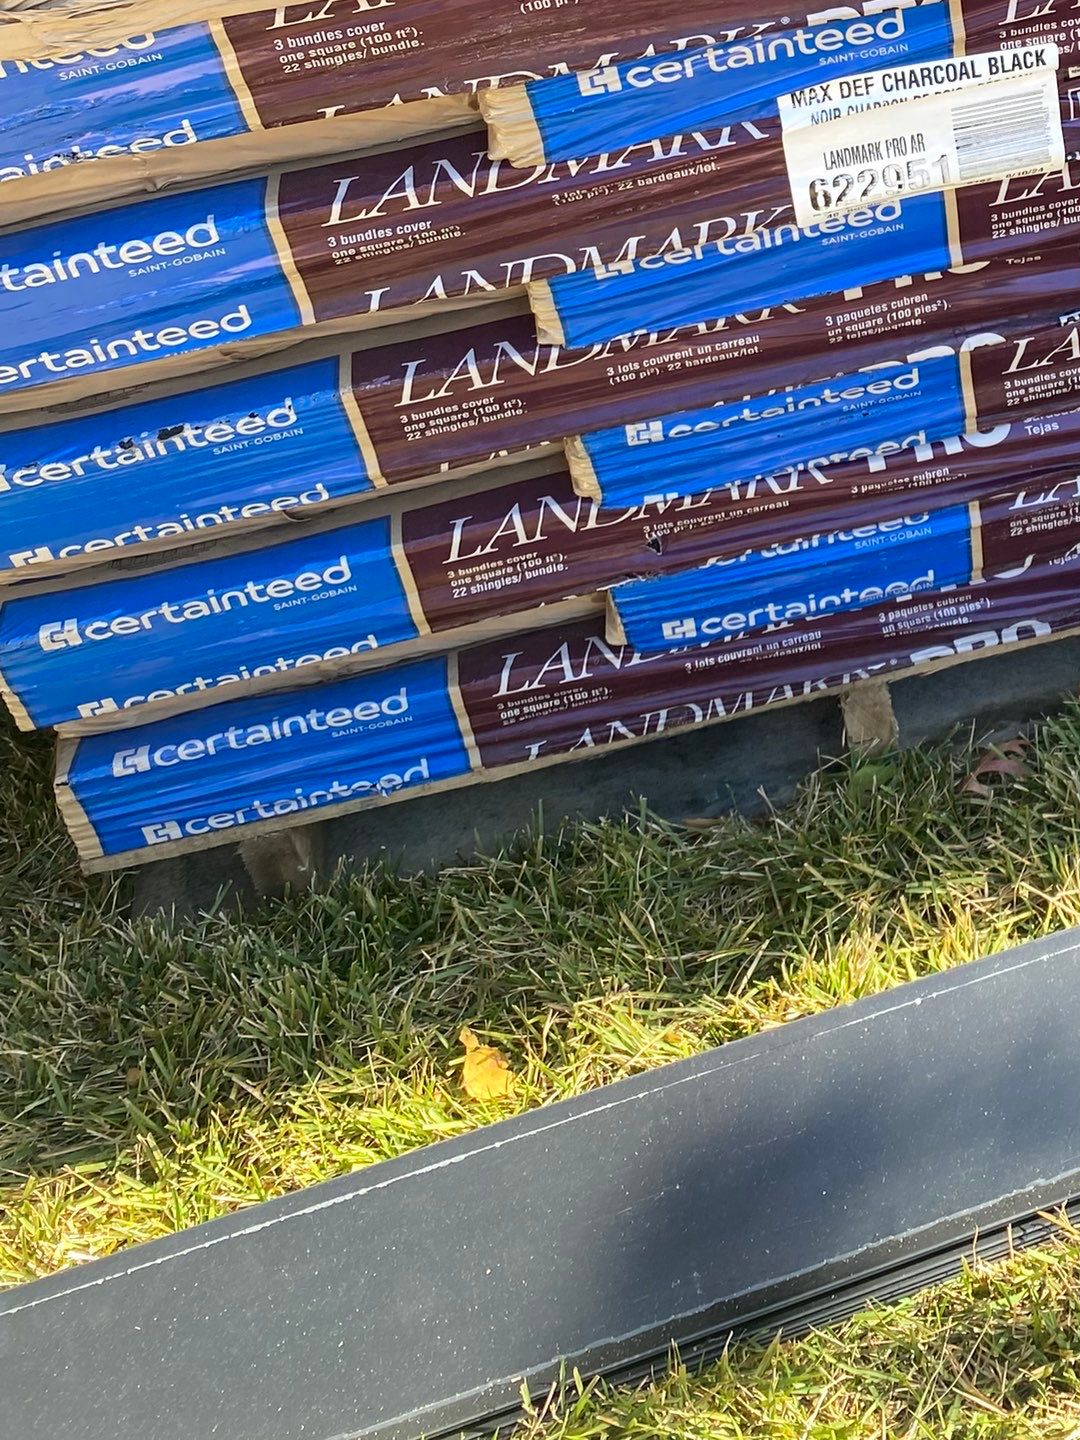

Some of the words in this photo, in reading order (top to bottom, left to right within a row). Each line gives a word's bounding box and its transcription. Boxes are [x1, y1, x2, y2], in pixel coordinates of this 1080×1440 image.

[625, 1, 906, 89] certainteed
[819, 43, 909, 65] SAINT-GOBAIN
[59, 53, 163, 81] SAINT-GOBAIN
[790, 84, 831, 109] MAX
[840, 75, 876, 99] DEF
[882, 59, 981, 95] CHARCOAL
[987, 48, 1047, 75] BLACK
[822, 138, 884, 170] LANDMARK
[886, 135, 907, 158] PRO
[909, 133, 925, 155] AR
[808, 154, 950, 212] 622951
[821, 223, 904, 245] SAINT-GOBAIN
[128, 247, 226, 278] SAINT-GOBAIN
[212, 427, 304, 456] SAINT-GOBAIN
[84, 555, 352, 641] certainteed
[273, 584, 357, 611] SAINT-GOBAIN
[153, 688, 410, 767] certainteed
